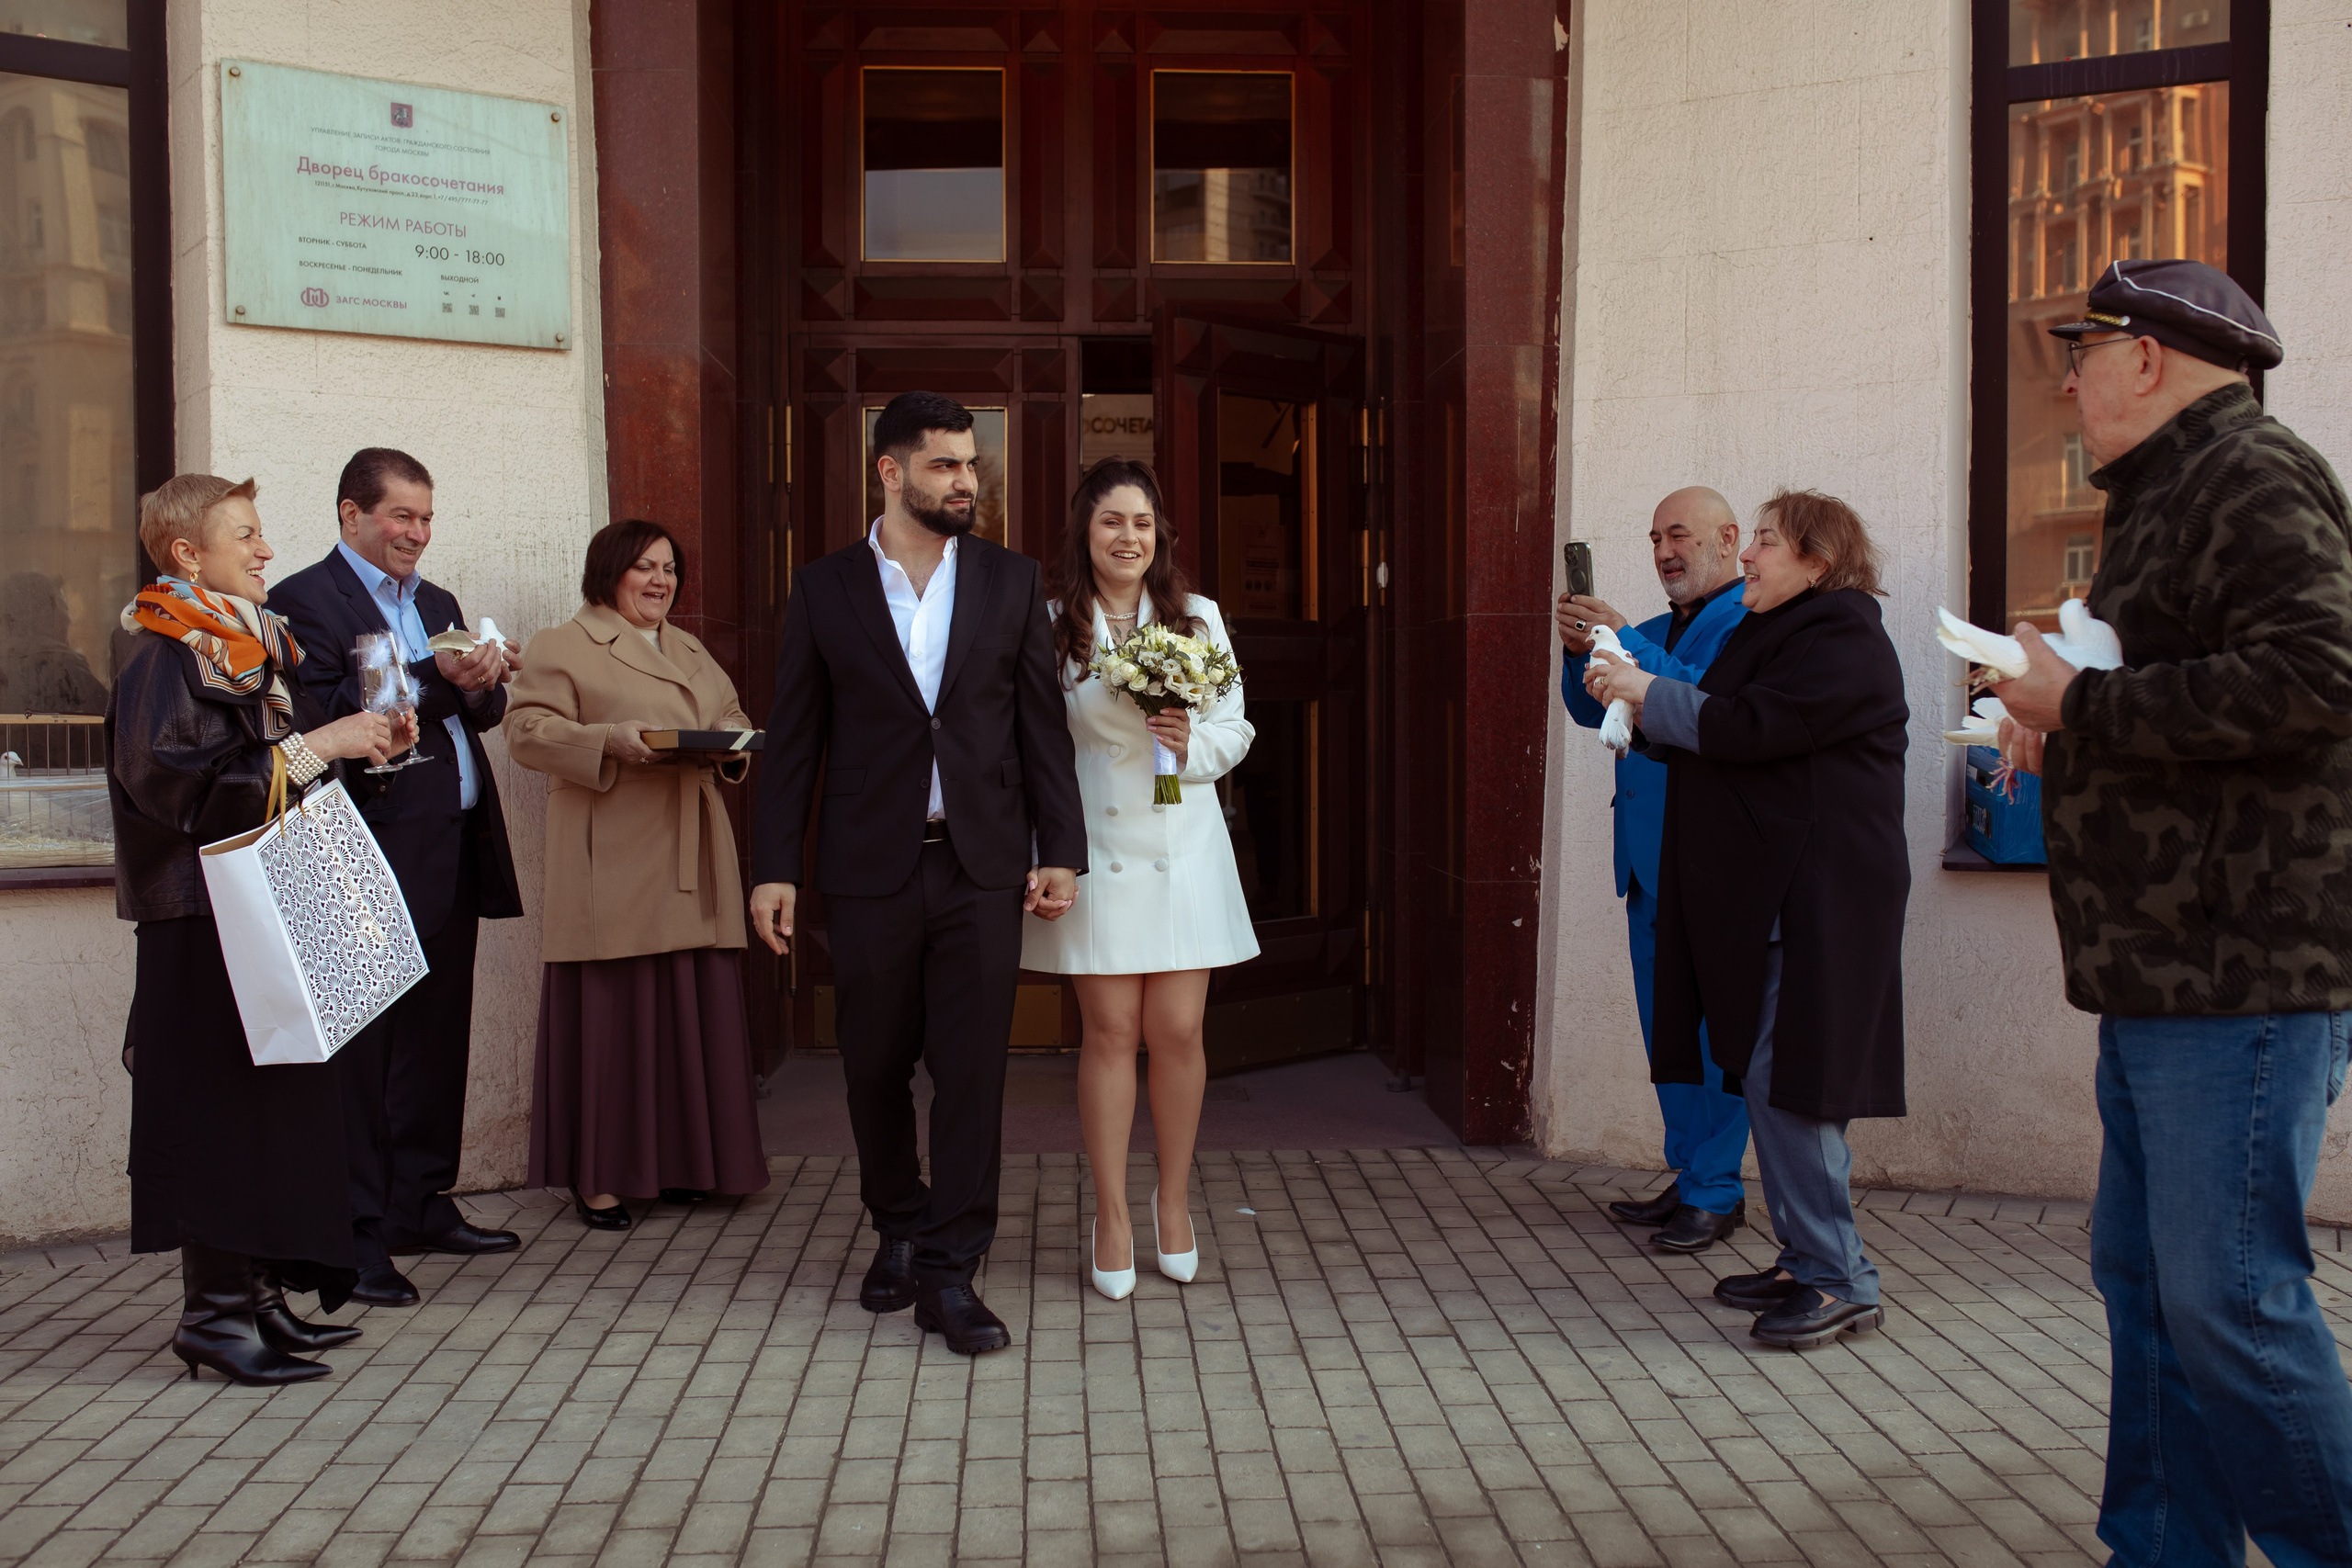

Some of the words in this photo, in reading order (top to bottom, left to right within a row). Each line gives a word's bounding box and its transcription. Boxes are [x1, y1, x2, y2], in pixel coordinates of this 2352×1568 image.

[311, 127, 351, 137] УПРАВЛЕНИЕ
[353, 132, 379, 141] ЗАПИСИ
[403, 139, 452, 151] ГРАЖДАНСКОГО
[453, 145, 491, 155] СОСТОЯНИЯ
[375, 144, 401, 153] ГОРОДА
[297, 155, 364, 181] Дворец
[368, 164, 504, 195] бракосочетания
[340, 211, 400, 231] РЕЖИМ
[405, 219, 467, 238] РАБОТЫ
[299, 236, 331, 245] ВТОРНИК
[335, 240, 367, 249] СУББОТА
[415, 244, 449, 261] 9:00
[466, 249, 504, 266] 18:00
[299, 260, 346, 271] ВОСКРЕСЕНЬЕ
[352, 265, 402, 276] ПОНЕДЕЛЬНИК
[440, 274, 479, 284] ВЫХОДНОЙ
[335, 295, 360, 305] ЗАГС
[362, 299, 407, 309] МОСКВЫ
